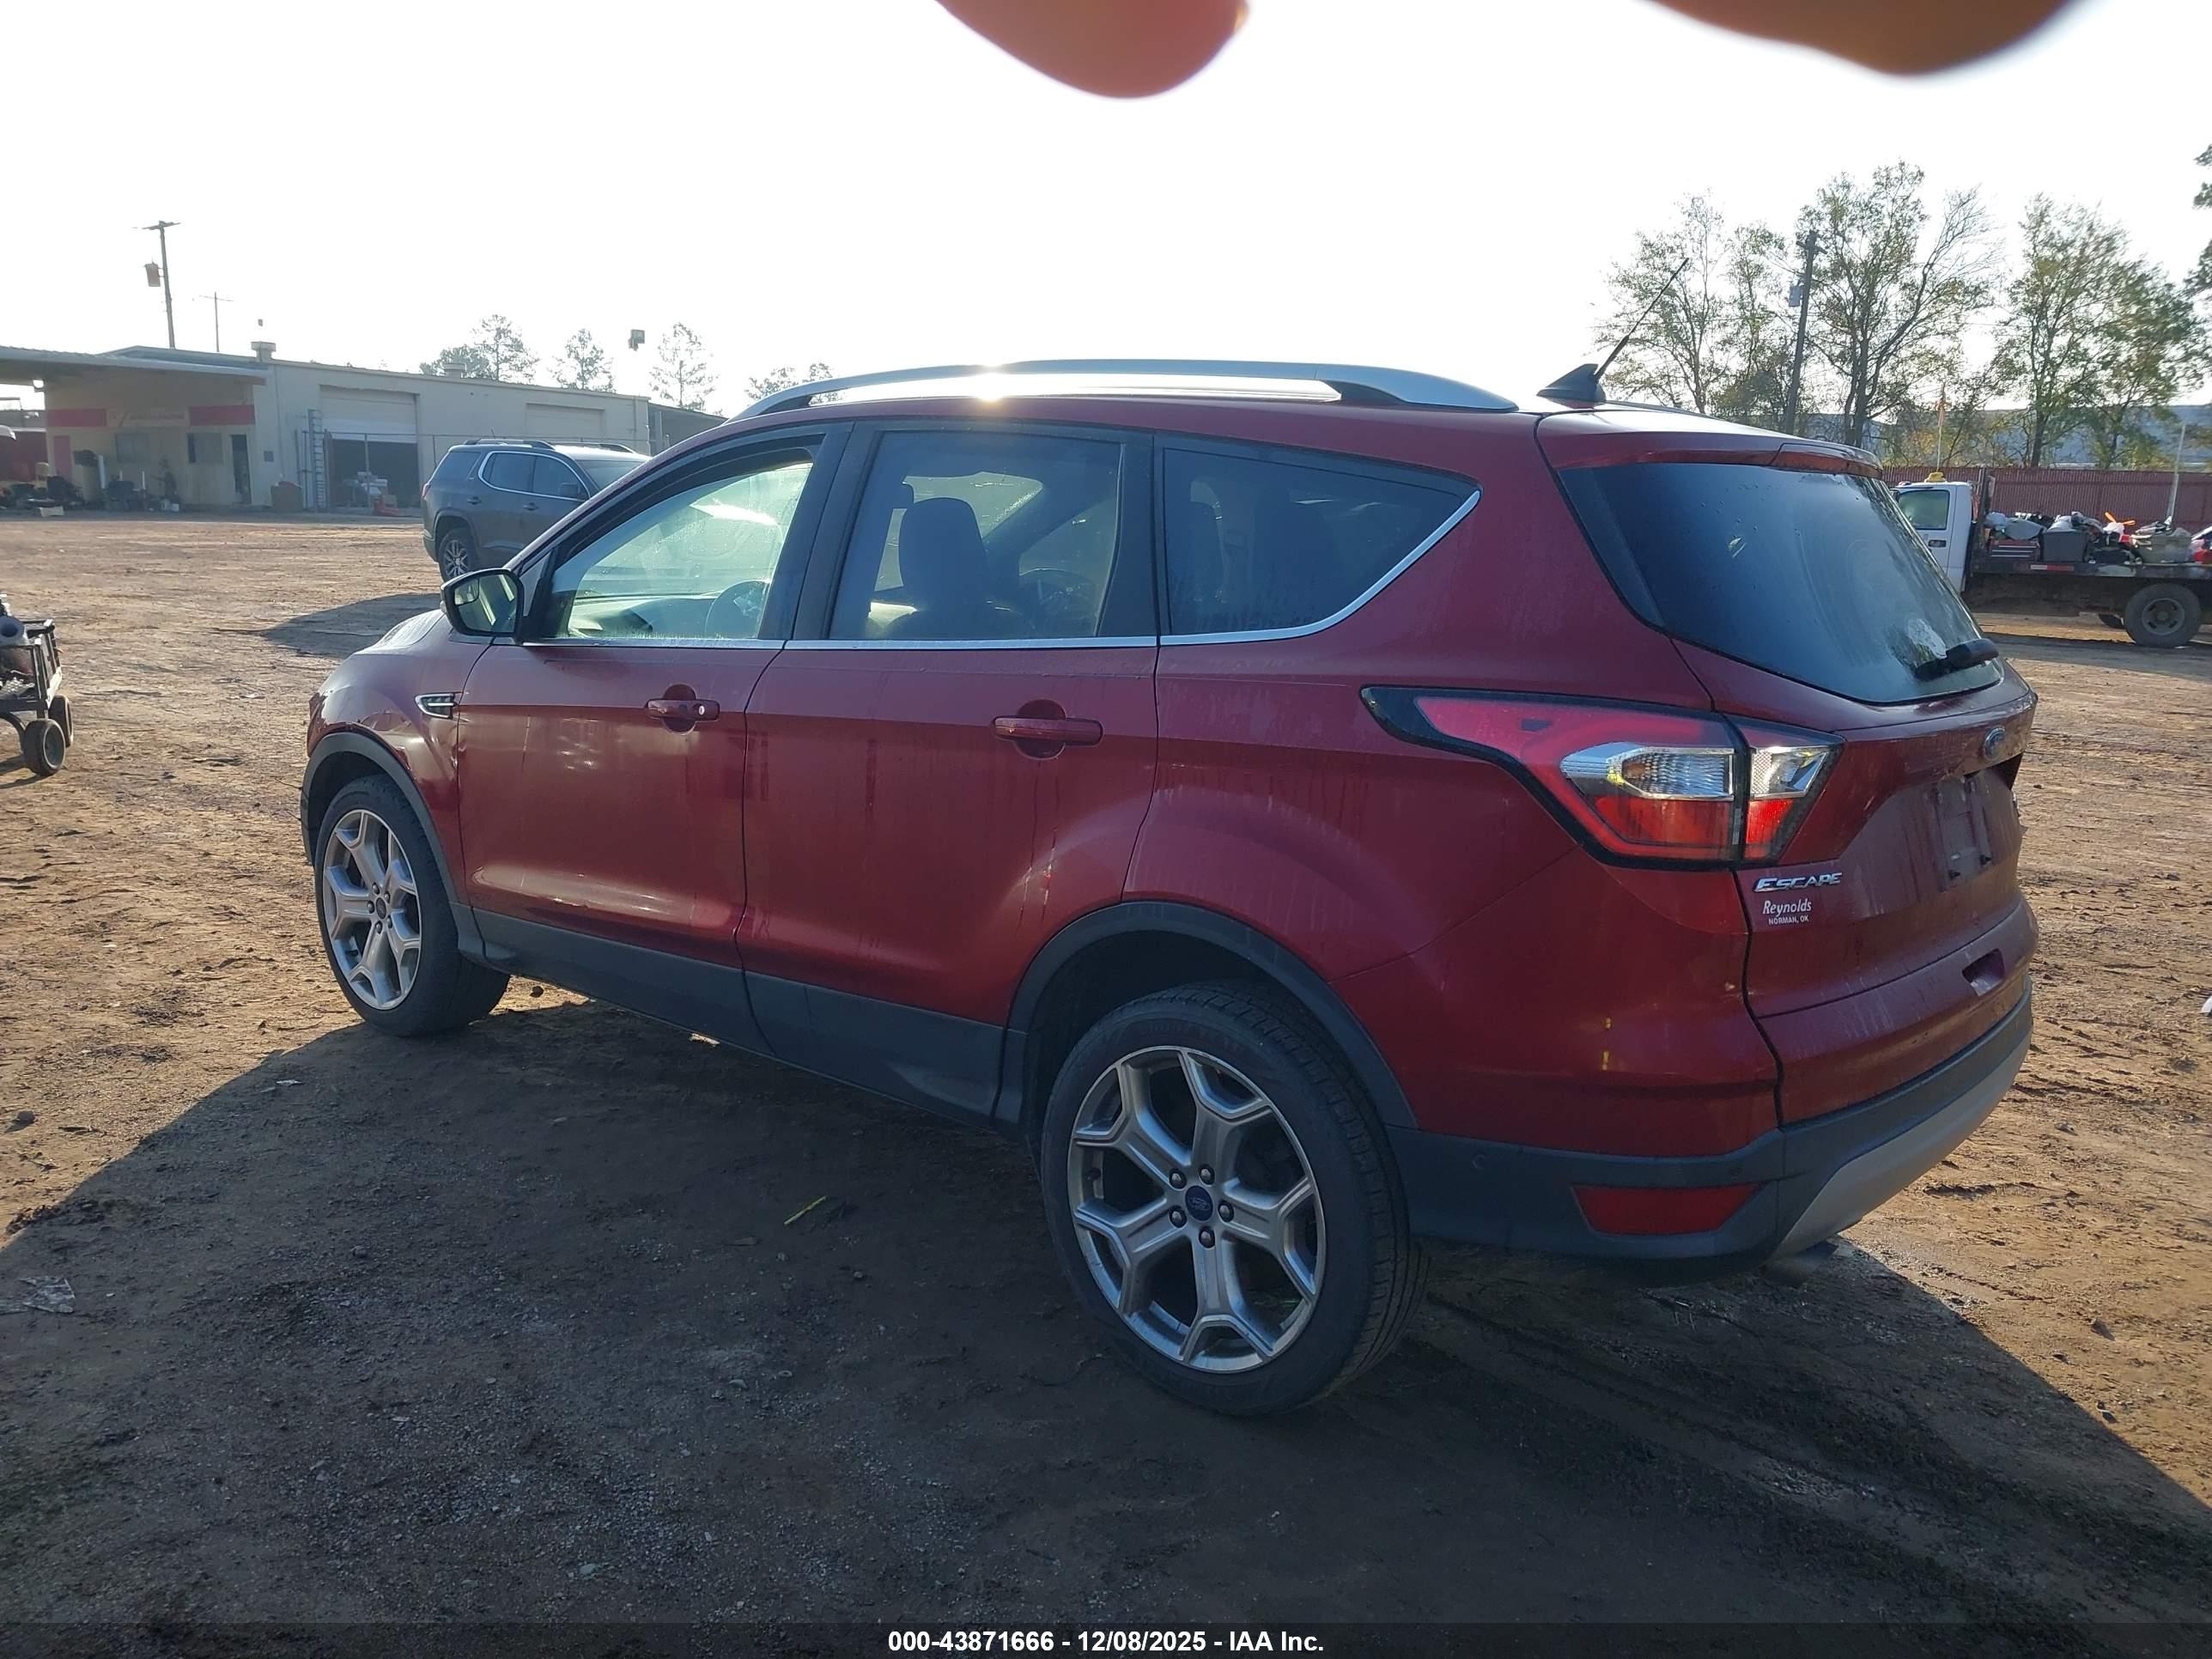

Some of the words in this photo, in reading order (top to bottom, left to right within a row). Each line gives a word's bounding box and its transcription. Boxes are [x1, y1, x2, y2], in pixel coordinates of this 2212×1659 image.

[1754, 872, 1843, 892] ESCAPE
[1762, 897, 1812, 917] Reynolds
[1769, 916, 1799, 926] NORMAN,
